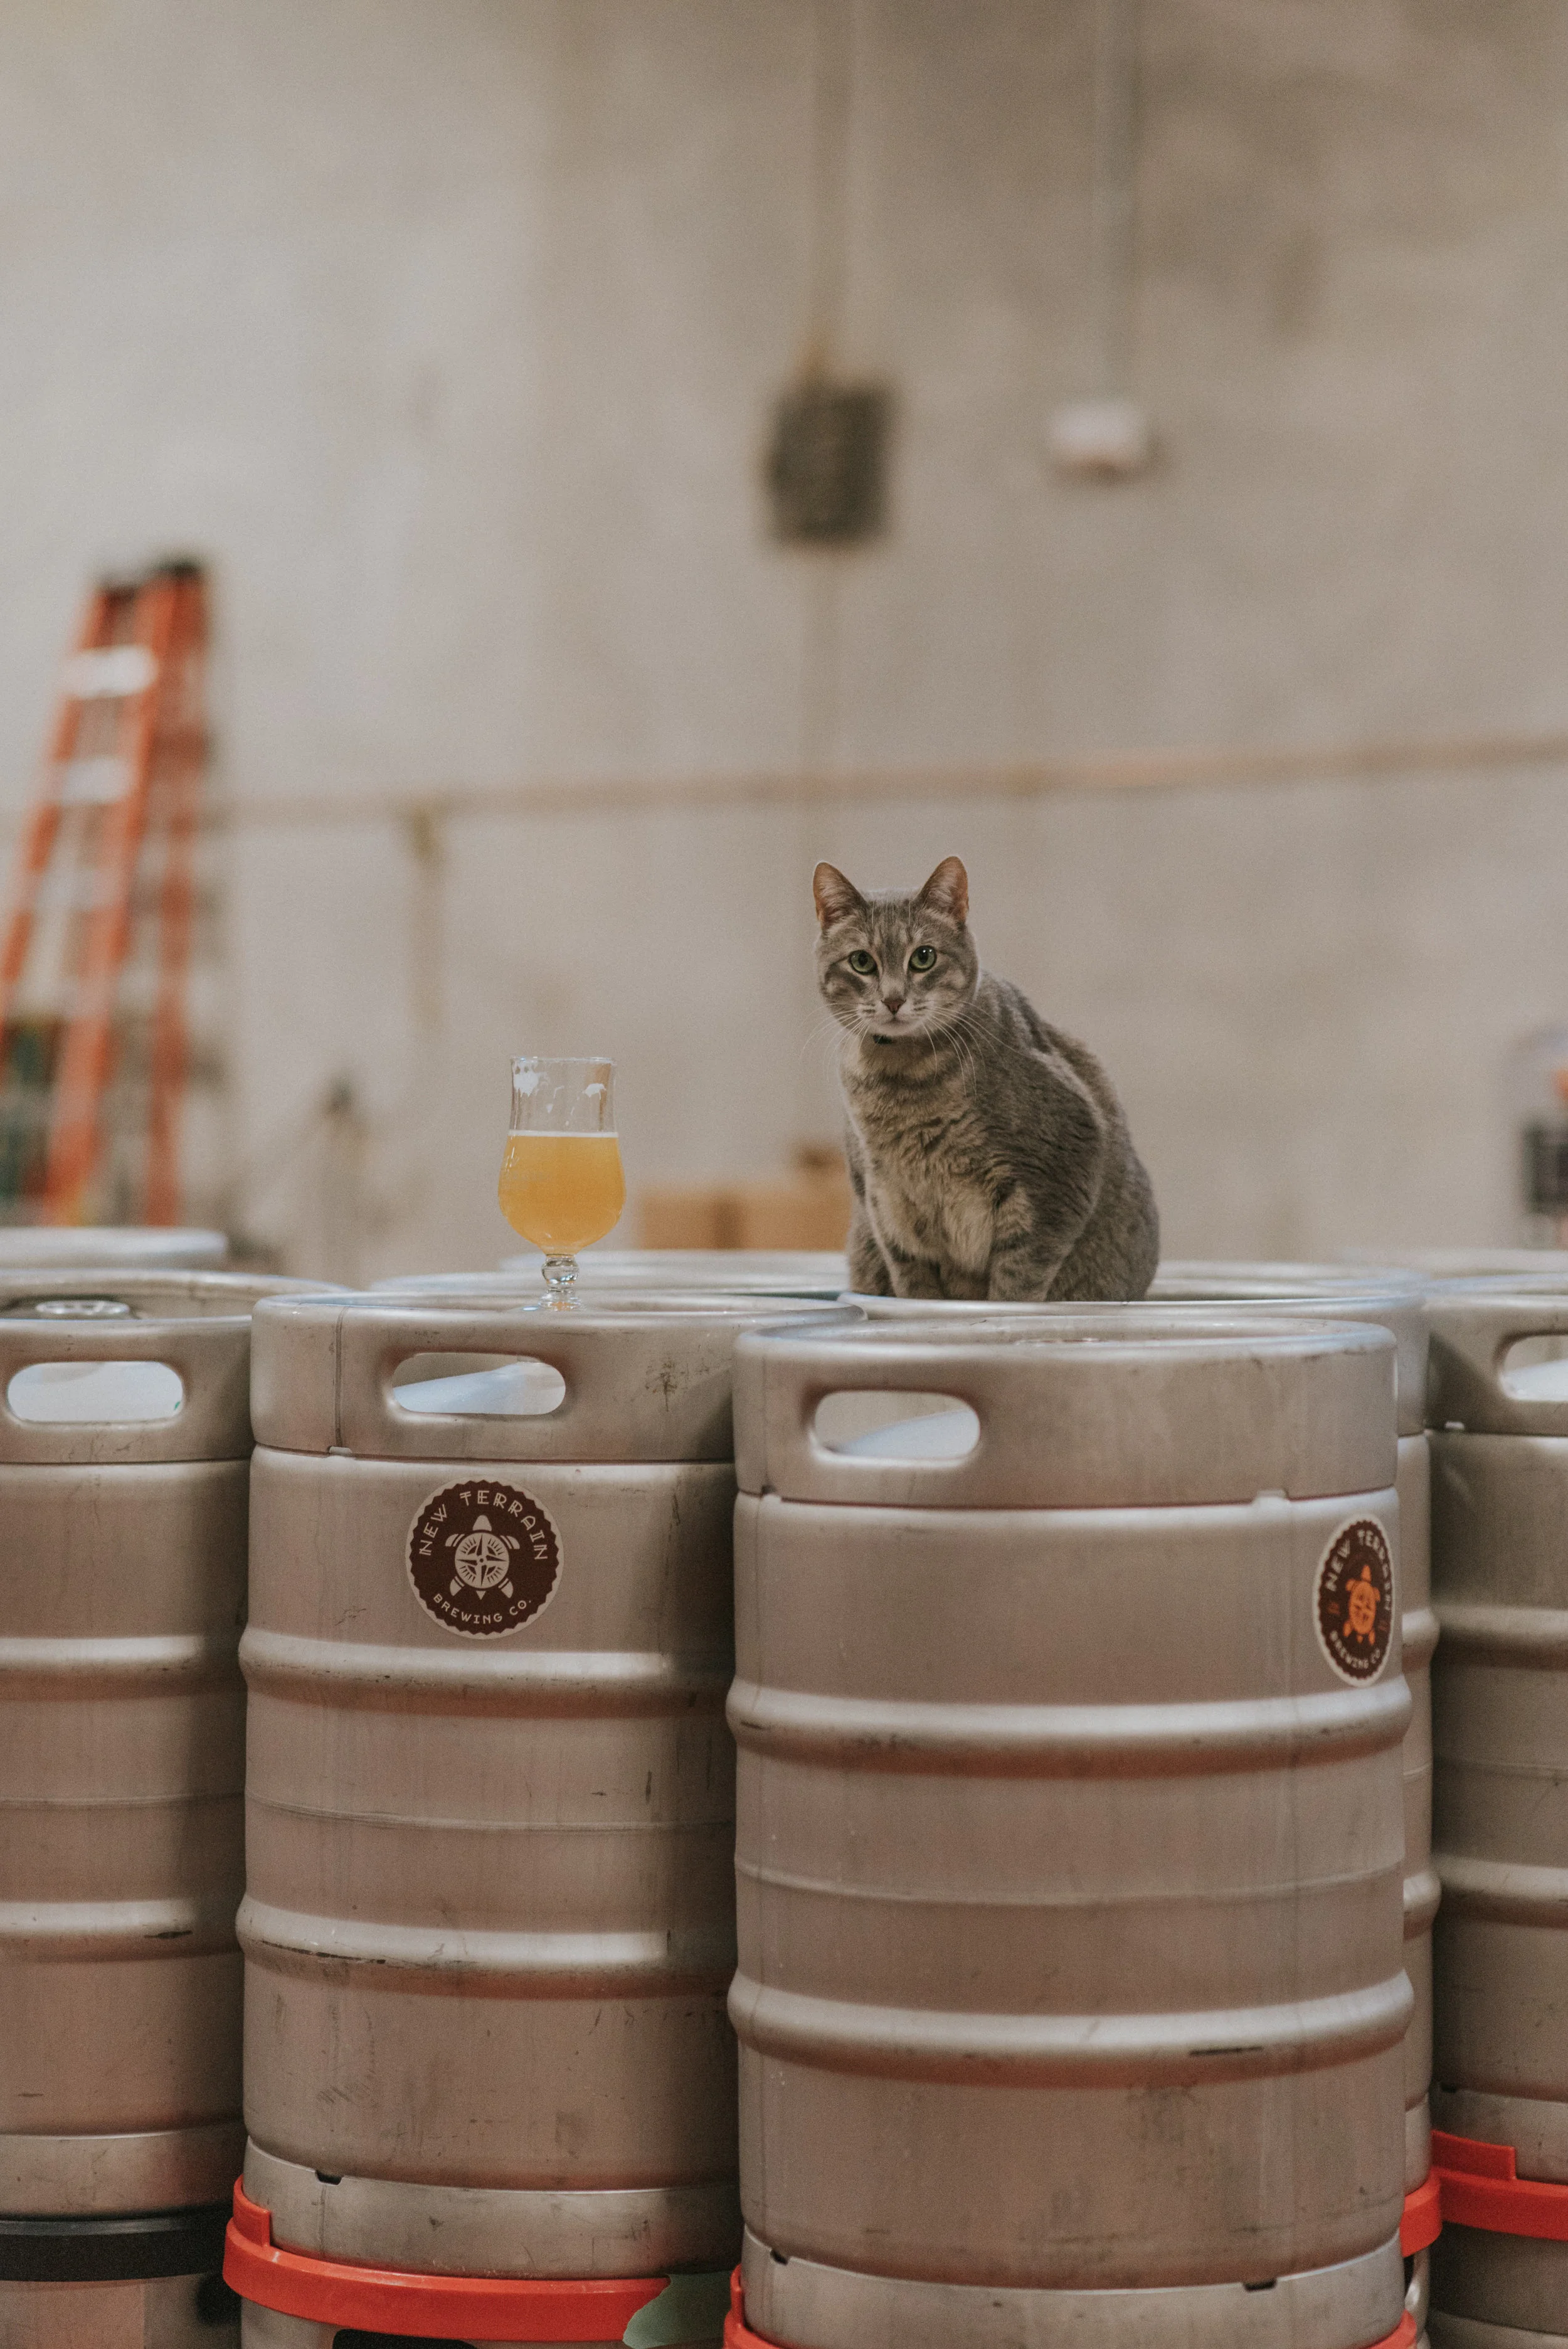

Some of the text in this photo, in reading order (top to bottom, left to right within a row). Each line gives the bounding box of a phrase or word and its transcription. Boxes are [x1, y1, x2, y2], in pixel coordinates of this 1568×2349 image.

[418, 1490, 548, 1560] NEW TERRAIN
[1325, 1538, 1350, 1592] NEW
[433, 1593, 532, 1625] BREWING CO.
